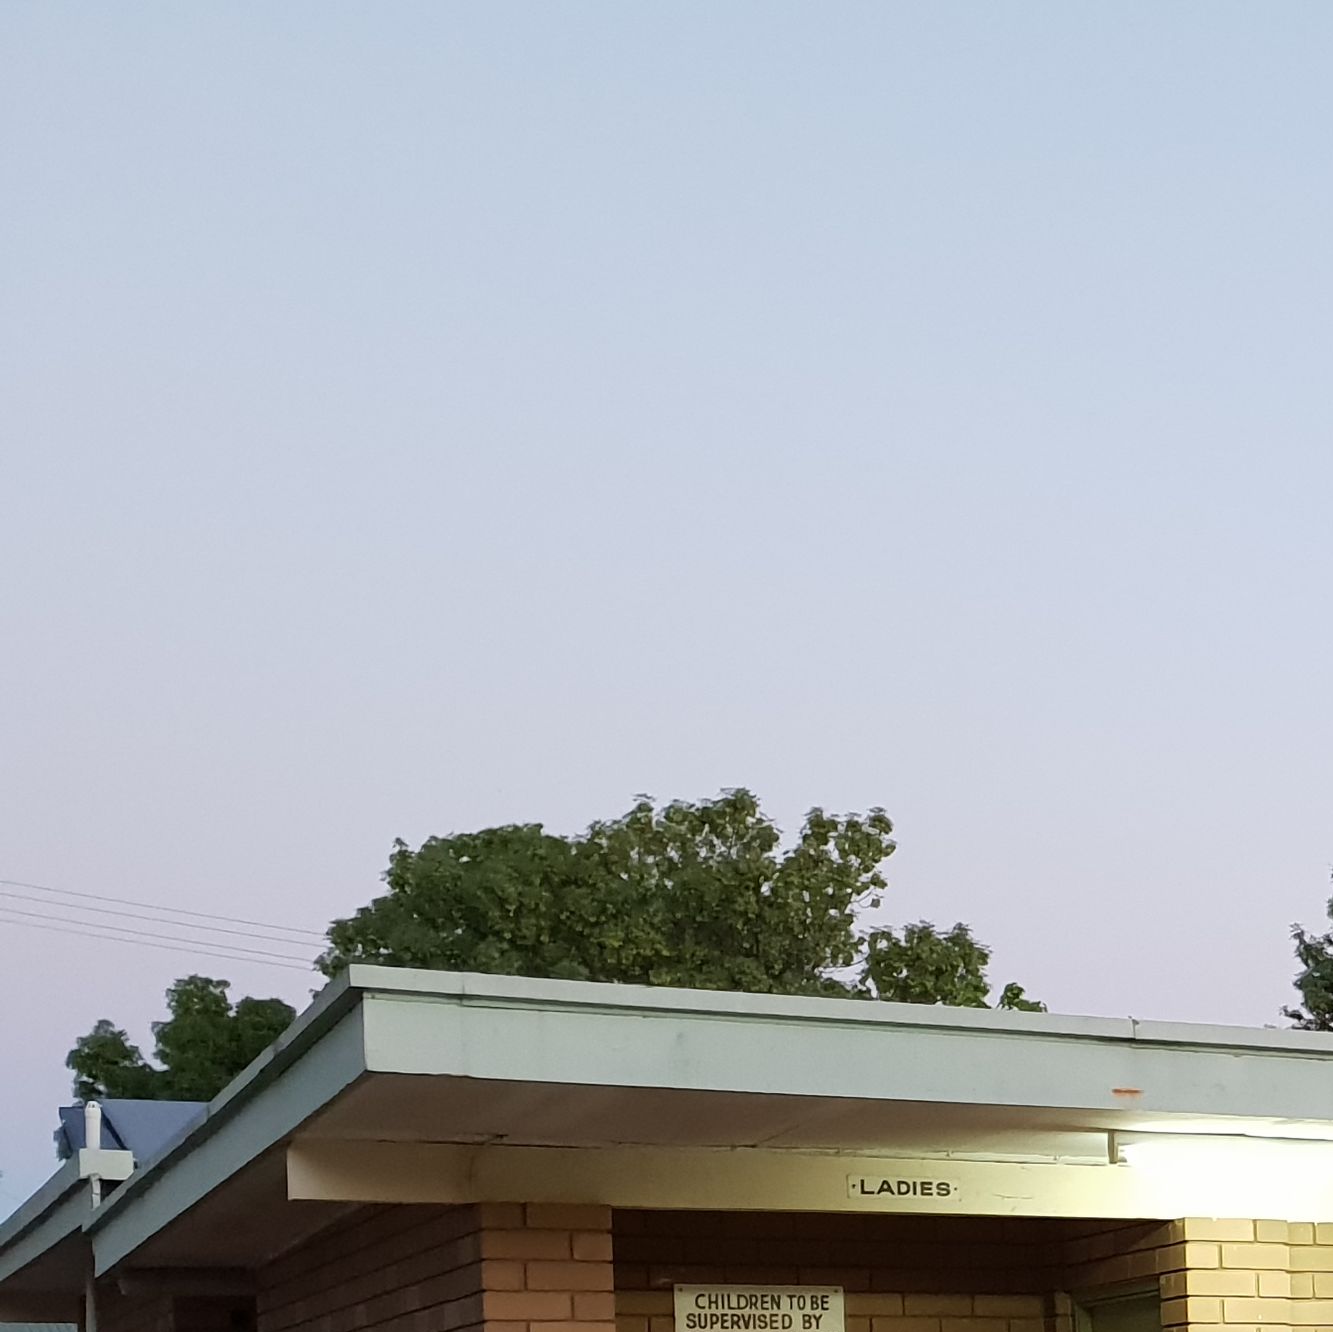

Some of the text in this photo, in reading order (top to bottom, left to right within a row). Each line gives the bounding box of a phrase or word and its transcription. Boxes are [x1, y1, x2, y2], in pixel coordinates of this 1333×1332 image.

[859, 1179, 951, 1196] LADIES
[695, 1293, 830, 1310] CHILDREN TO BE
[686, 1313, 823, 1330] SUPERVISED BY
